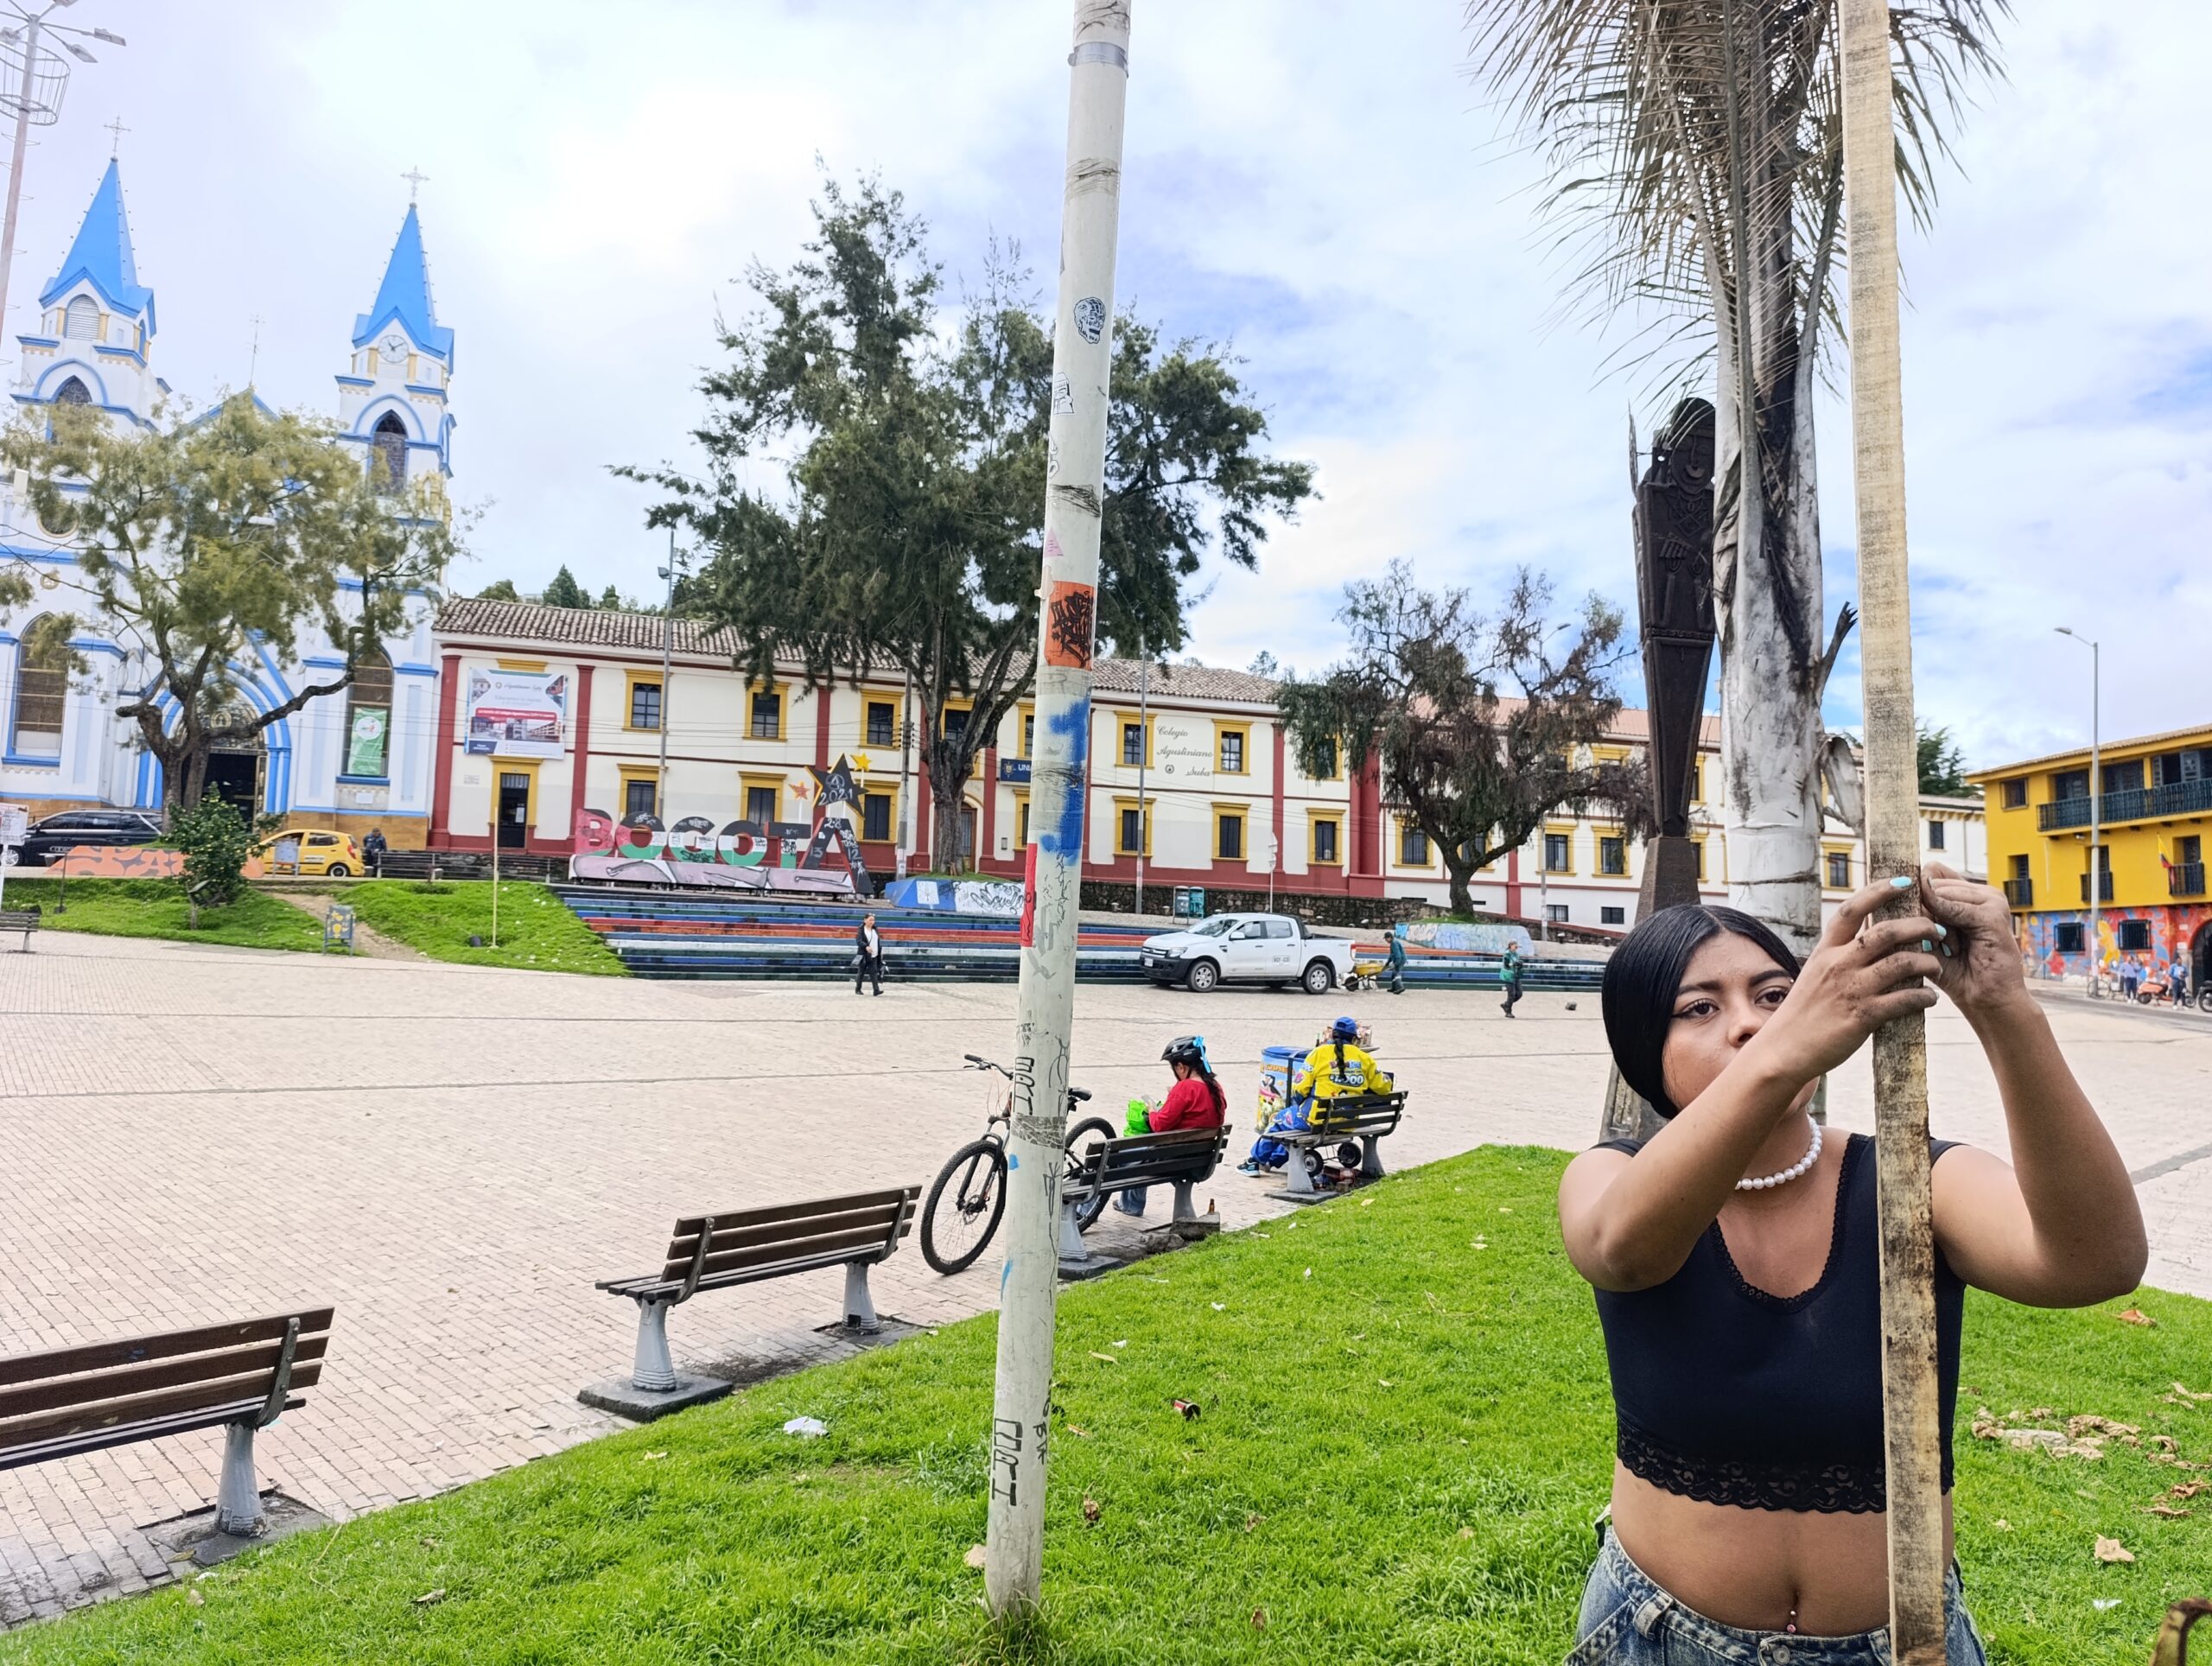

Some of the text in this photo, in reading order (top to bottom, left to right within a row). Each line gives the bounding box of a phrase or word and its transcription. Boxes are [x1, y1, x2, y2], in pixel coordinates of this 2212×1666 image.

[1157, 725, 1189, 740] Colegio
[1156, 745, 1213, 759] Agustiniano
[1018, 763, 1032, 772] UNI
[1185, 766, 1211, 776] Suba
[817, 788, 853, 805] 2021
